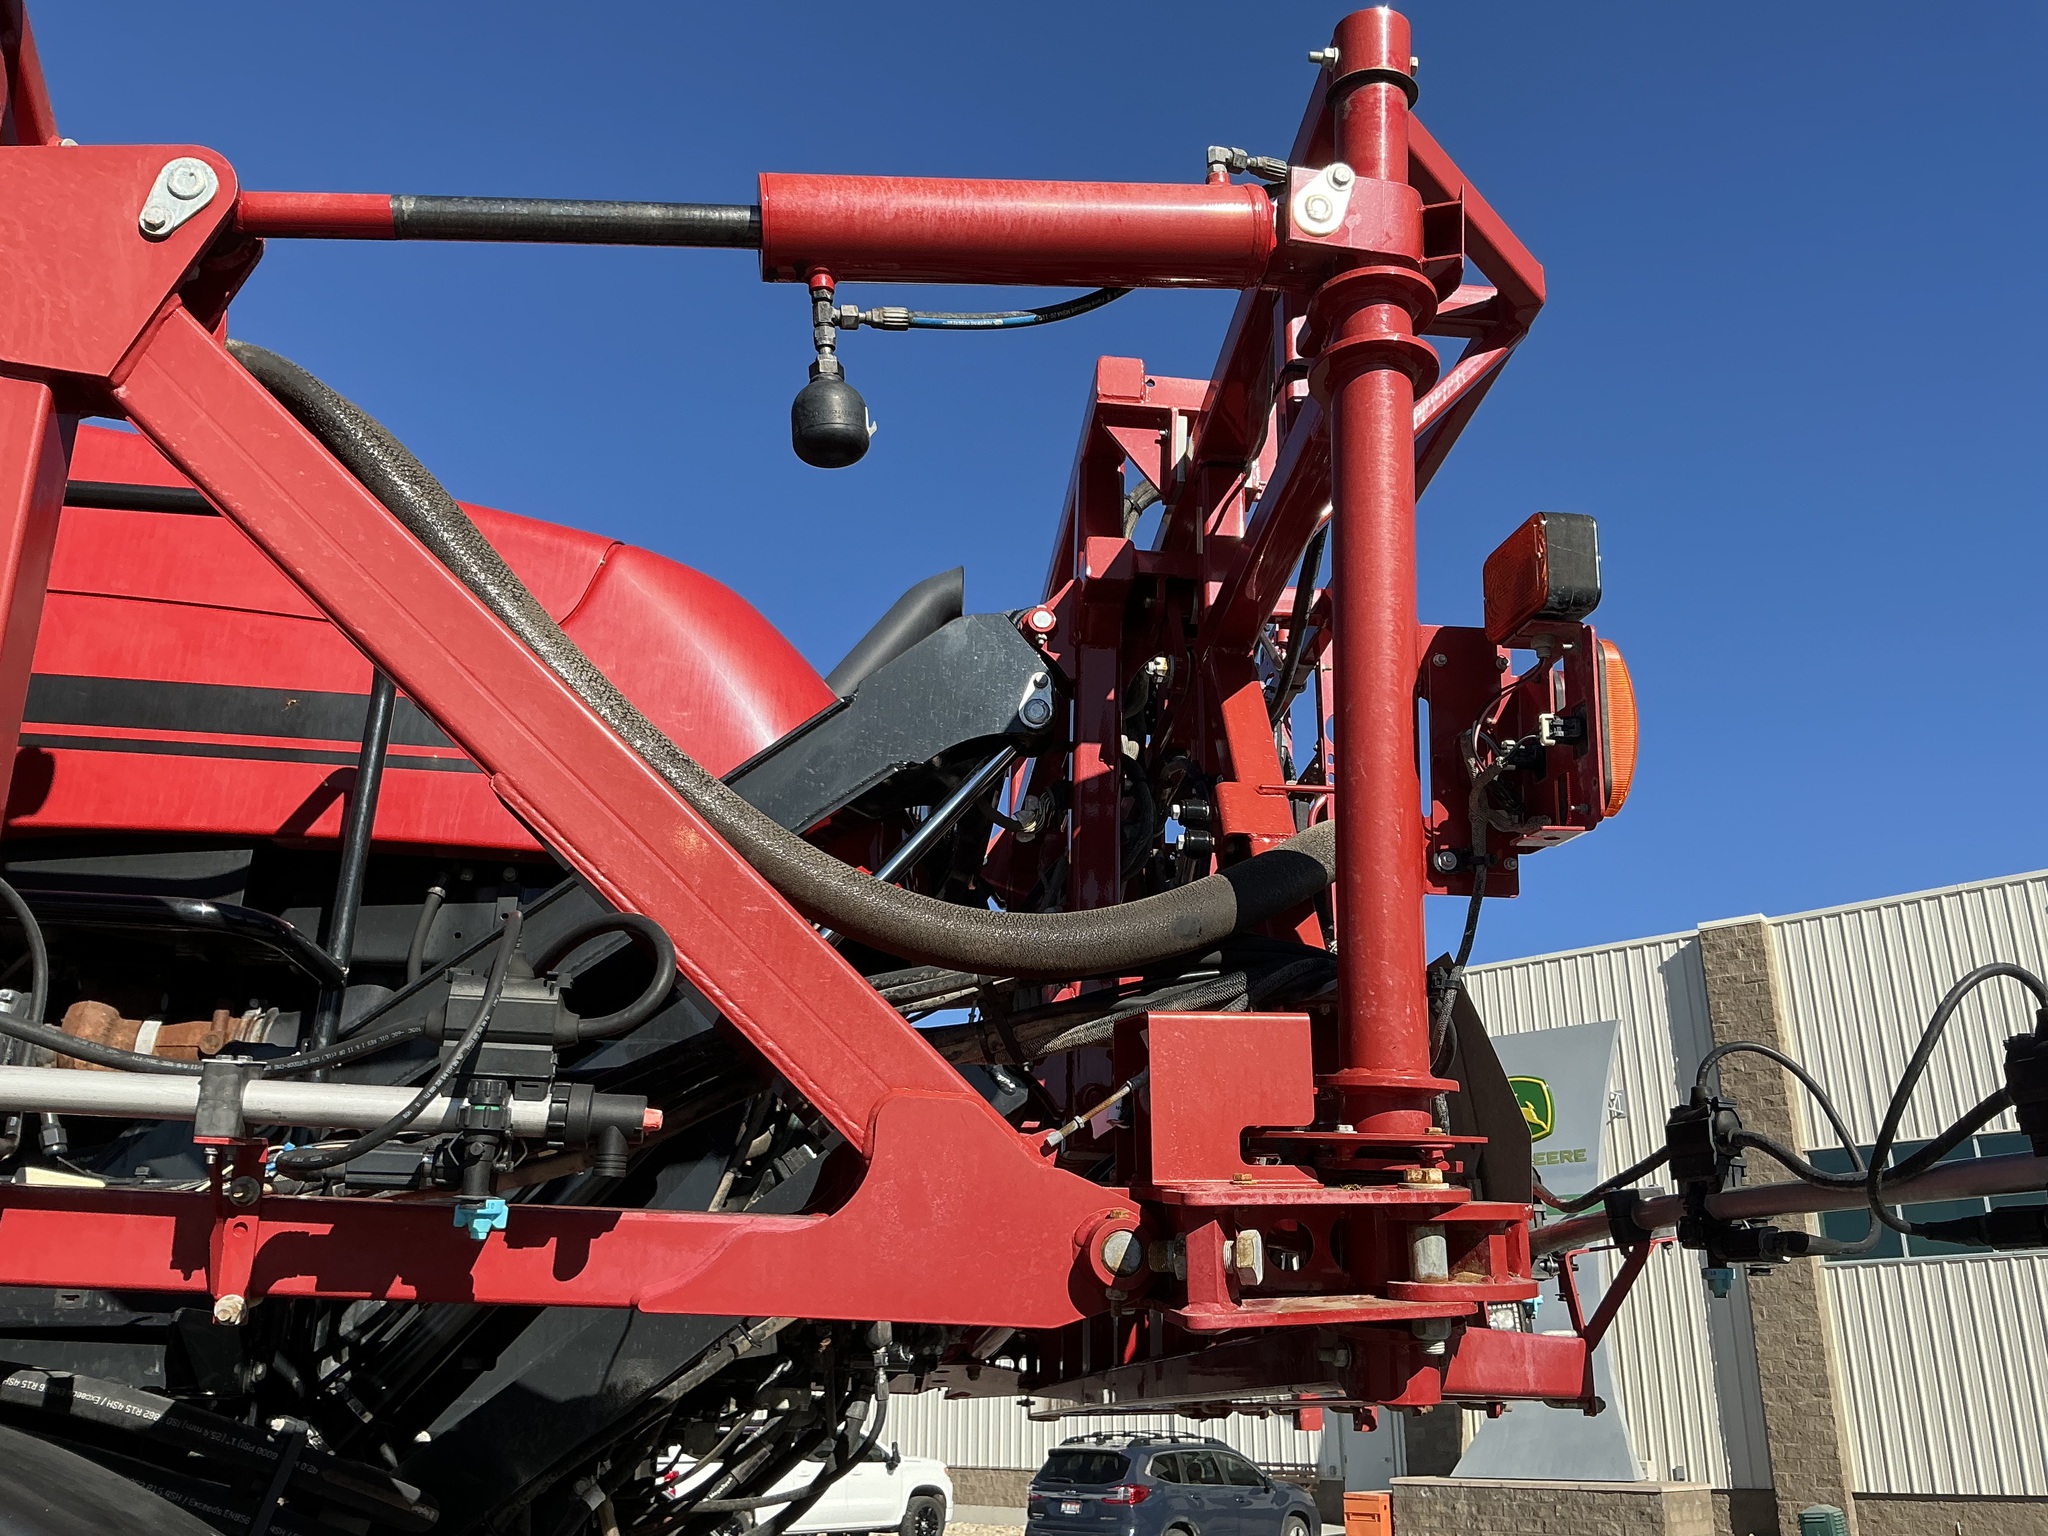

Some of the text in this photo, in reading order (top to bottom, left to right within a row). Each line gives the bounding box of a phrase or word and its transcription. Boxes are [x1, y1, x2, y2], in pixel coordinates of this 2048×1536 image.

[379, 1034, 389, 1042] OIL
[1532, 1149, 1587, 1166] EERE
[21, 1379, 39, 1391] R15
[100, 1396, 108, 1406] /
[106, 1399, 125, 1411] 4SH
[125, 1405, 143, 1417] R15
[164, 1489, 183, 1502] 4SH
[188, 1498, 223, 1516] Exceeds
[222, 1509, 252, 1525] EN856
